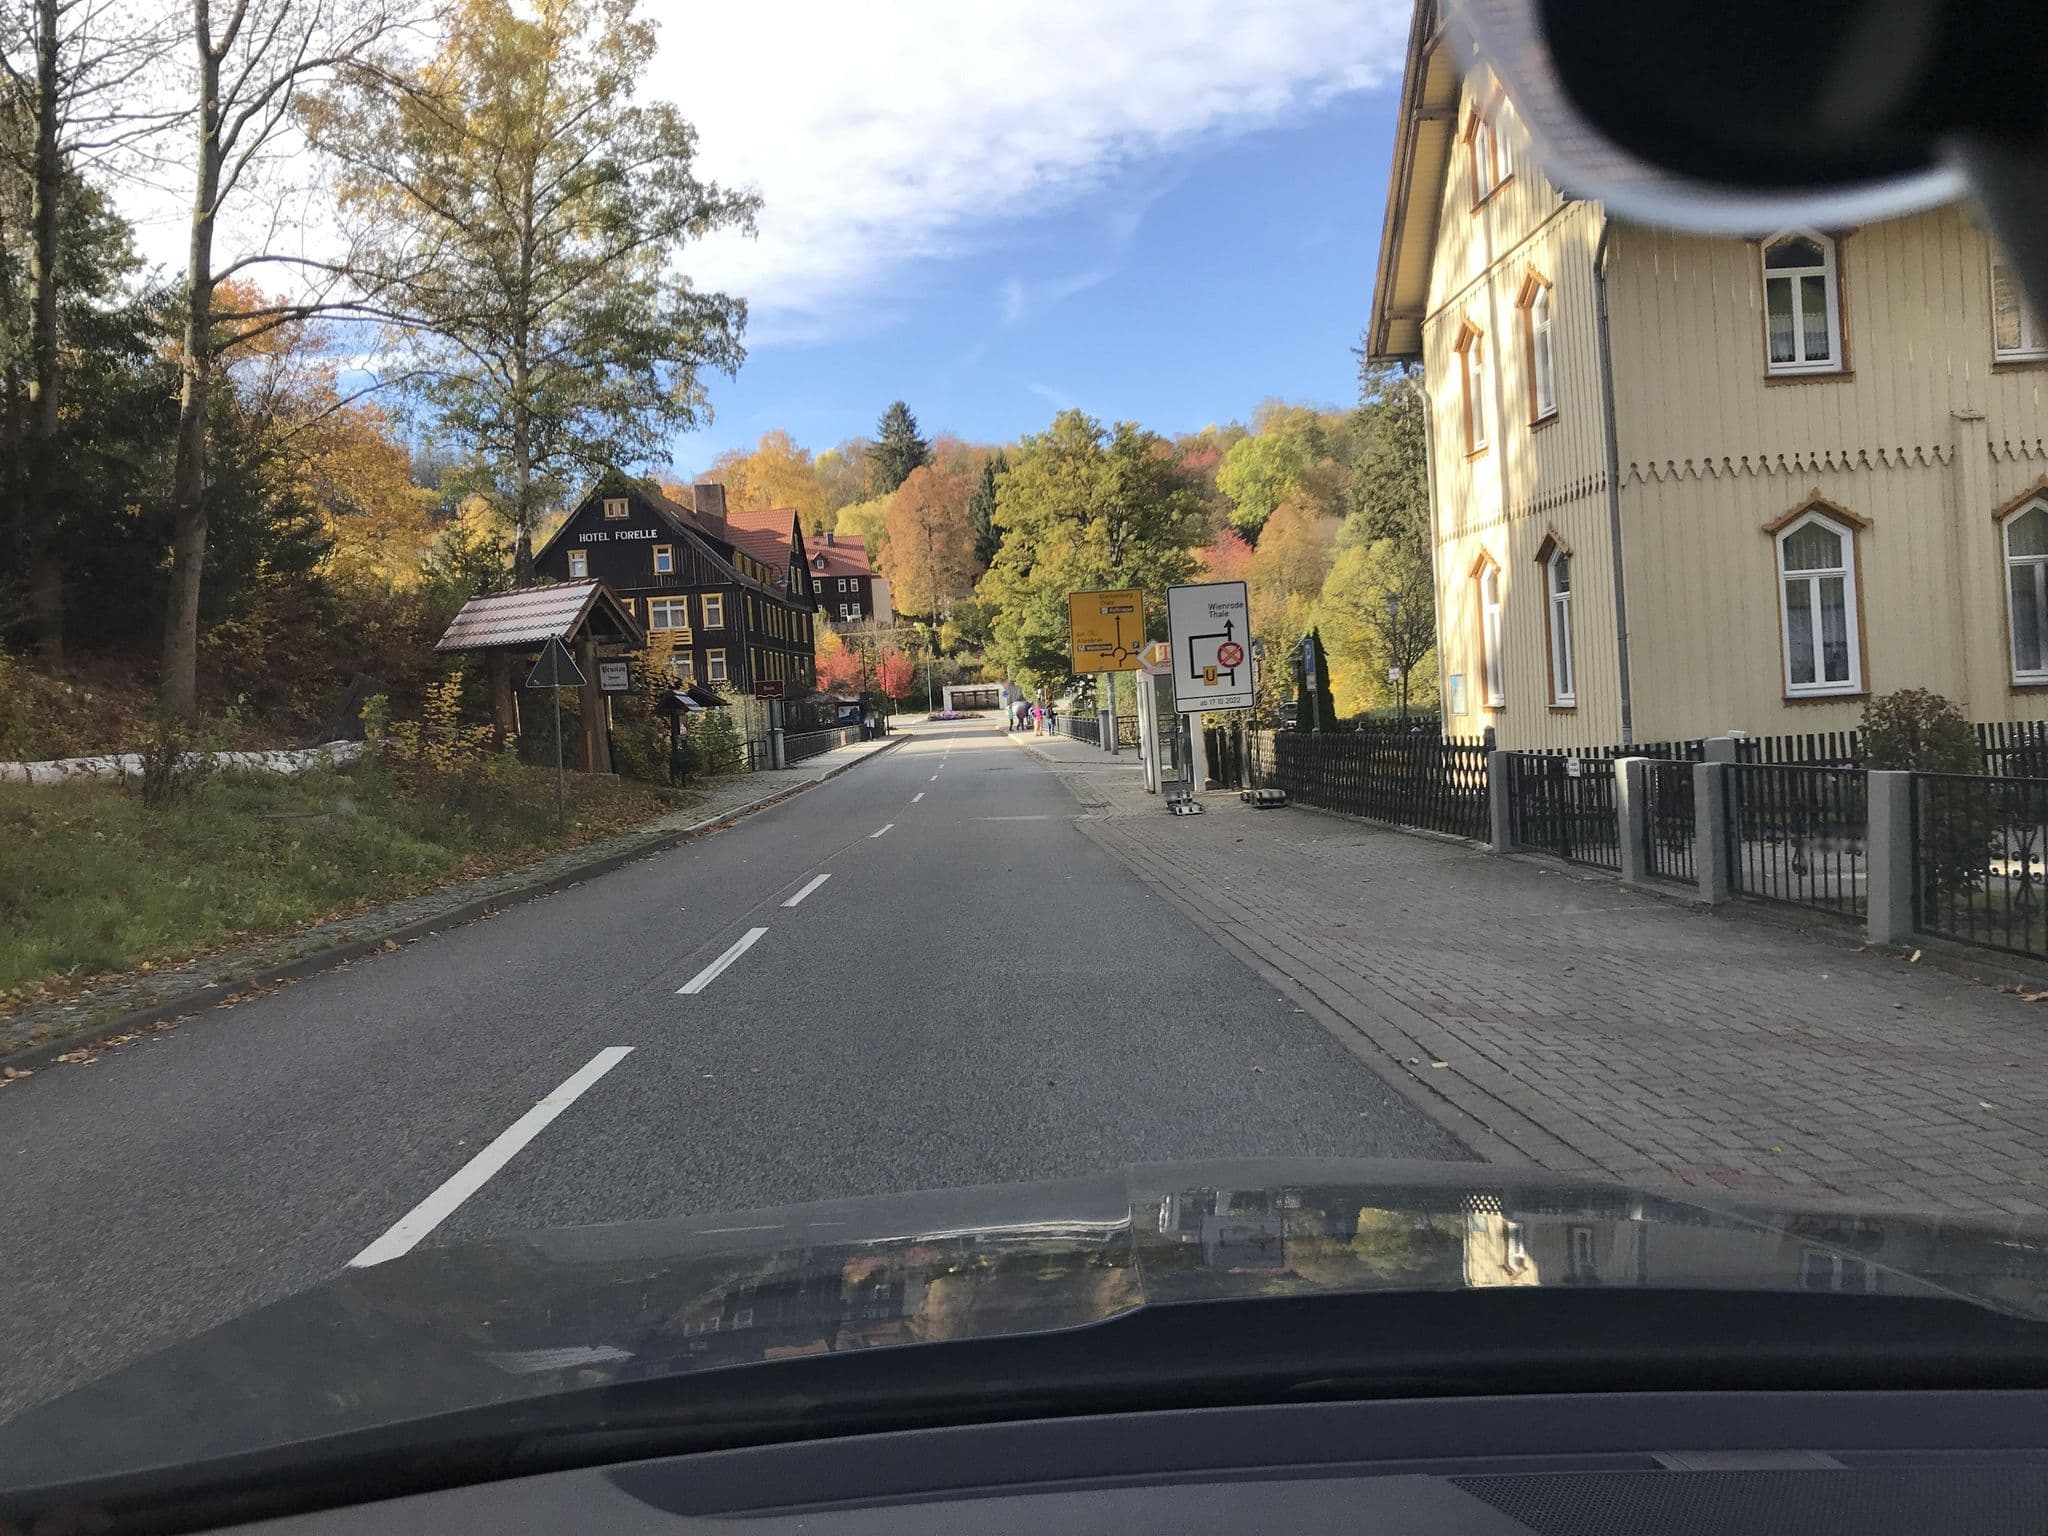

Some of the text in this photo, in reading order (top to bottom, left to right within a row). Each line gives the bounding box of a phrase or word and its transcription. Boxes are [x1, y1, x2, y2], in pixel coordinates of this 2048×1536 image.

[579, 529, 658, 542] HOTEL FORELLE
[1208, 601, 1244, 611] Wienrode
[1209, 610, 1229, 618] Thale
[1205, 669, 1216, 682] U
